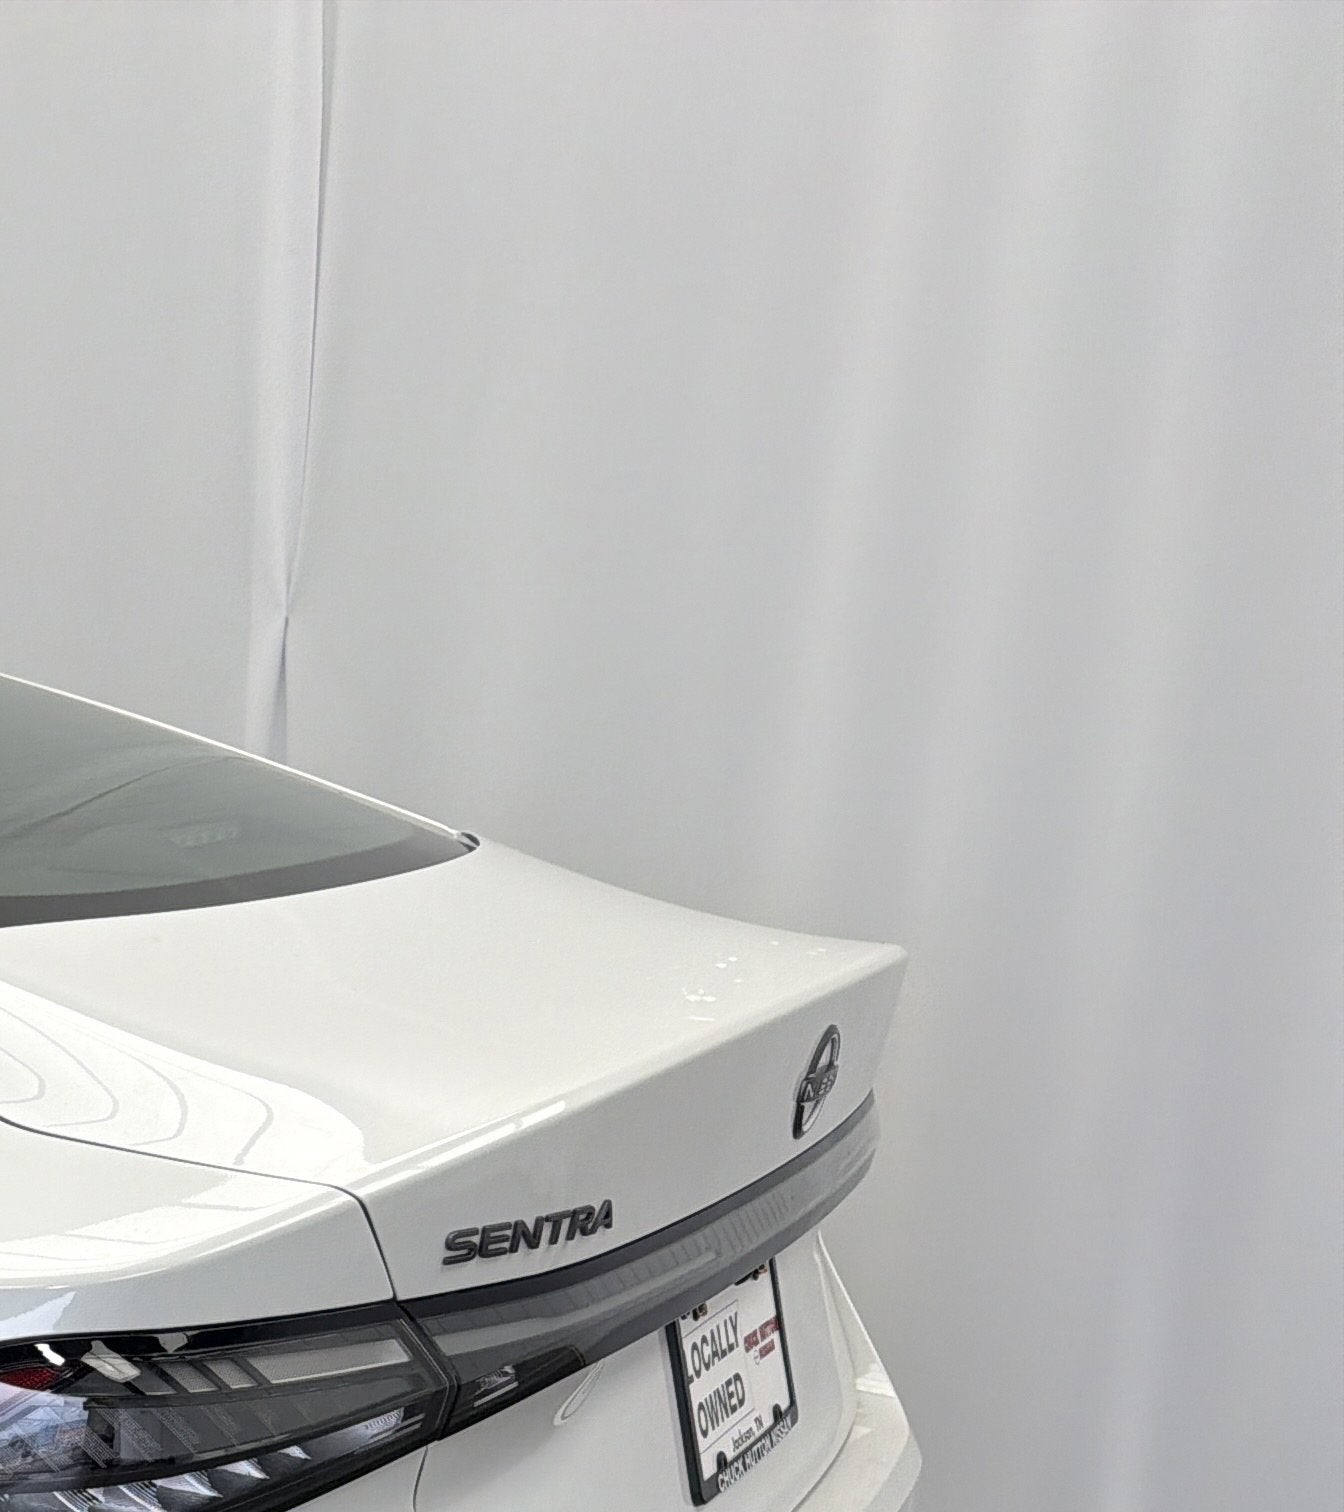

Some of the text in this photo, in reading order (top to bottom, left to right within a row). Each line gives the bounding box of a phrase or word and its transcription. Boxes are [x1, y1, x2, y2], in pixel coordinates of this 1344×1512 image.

[442, 1199, 613, 1266] SENTRA
[697, 1372, 746, 1440] OWNED
[718, 1456, 745, 1492] CHUCK
